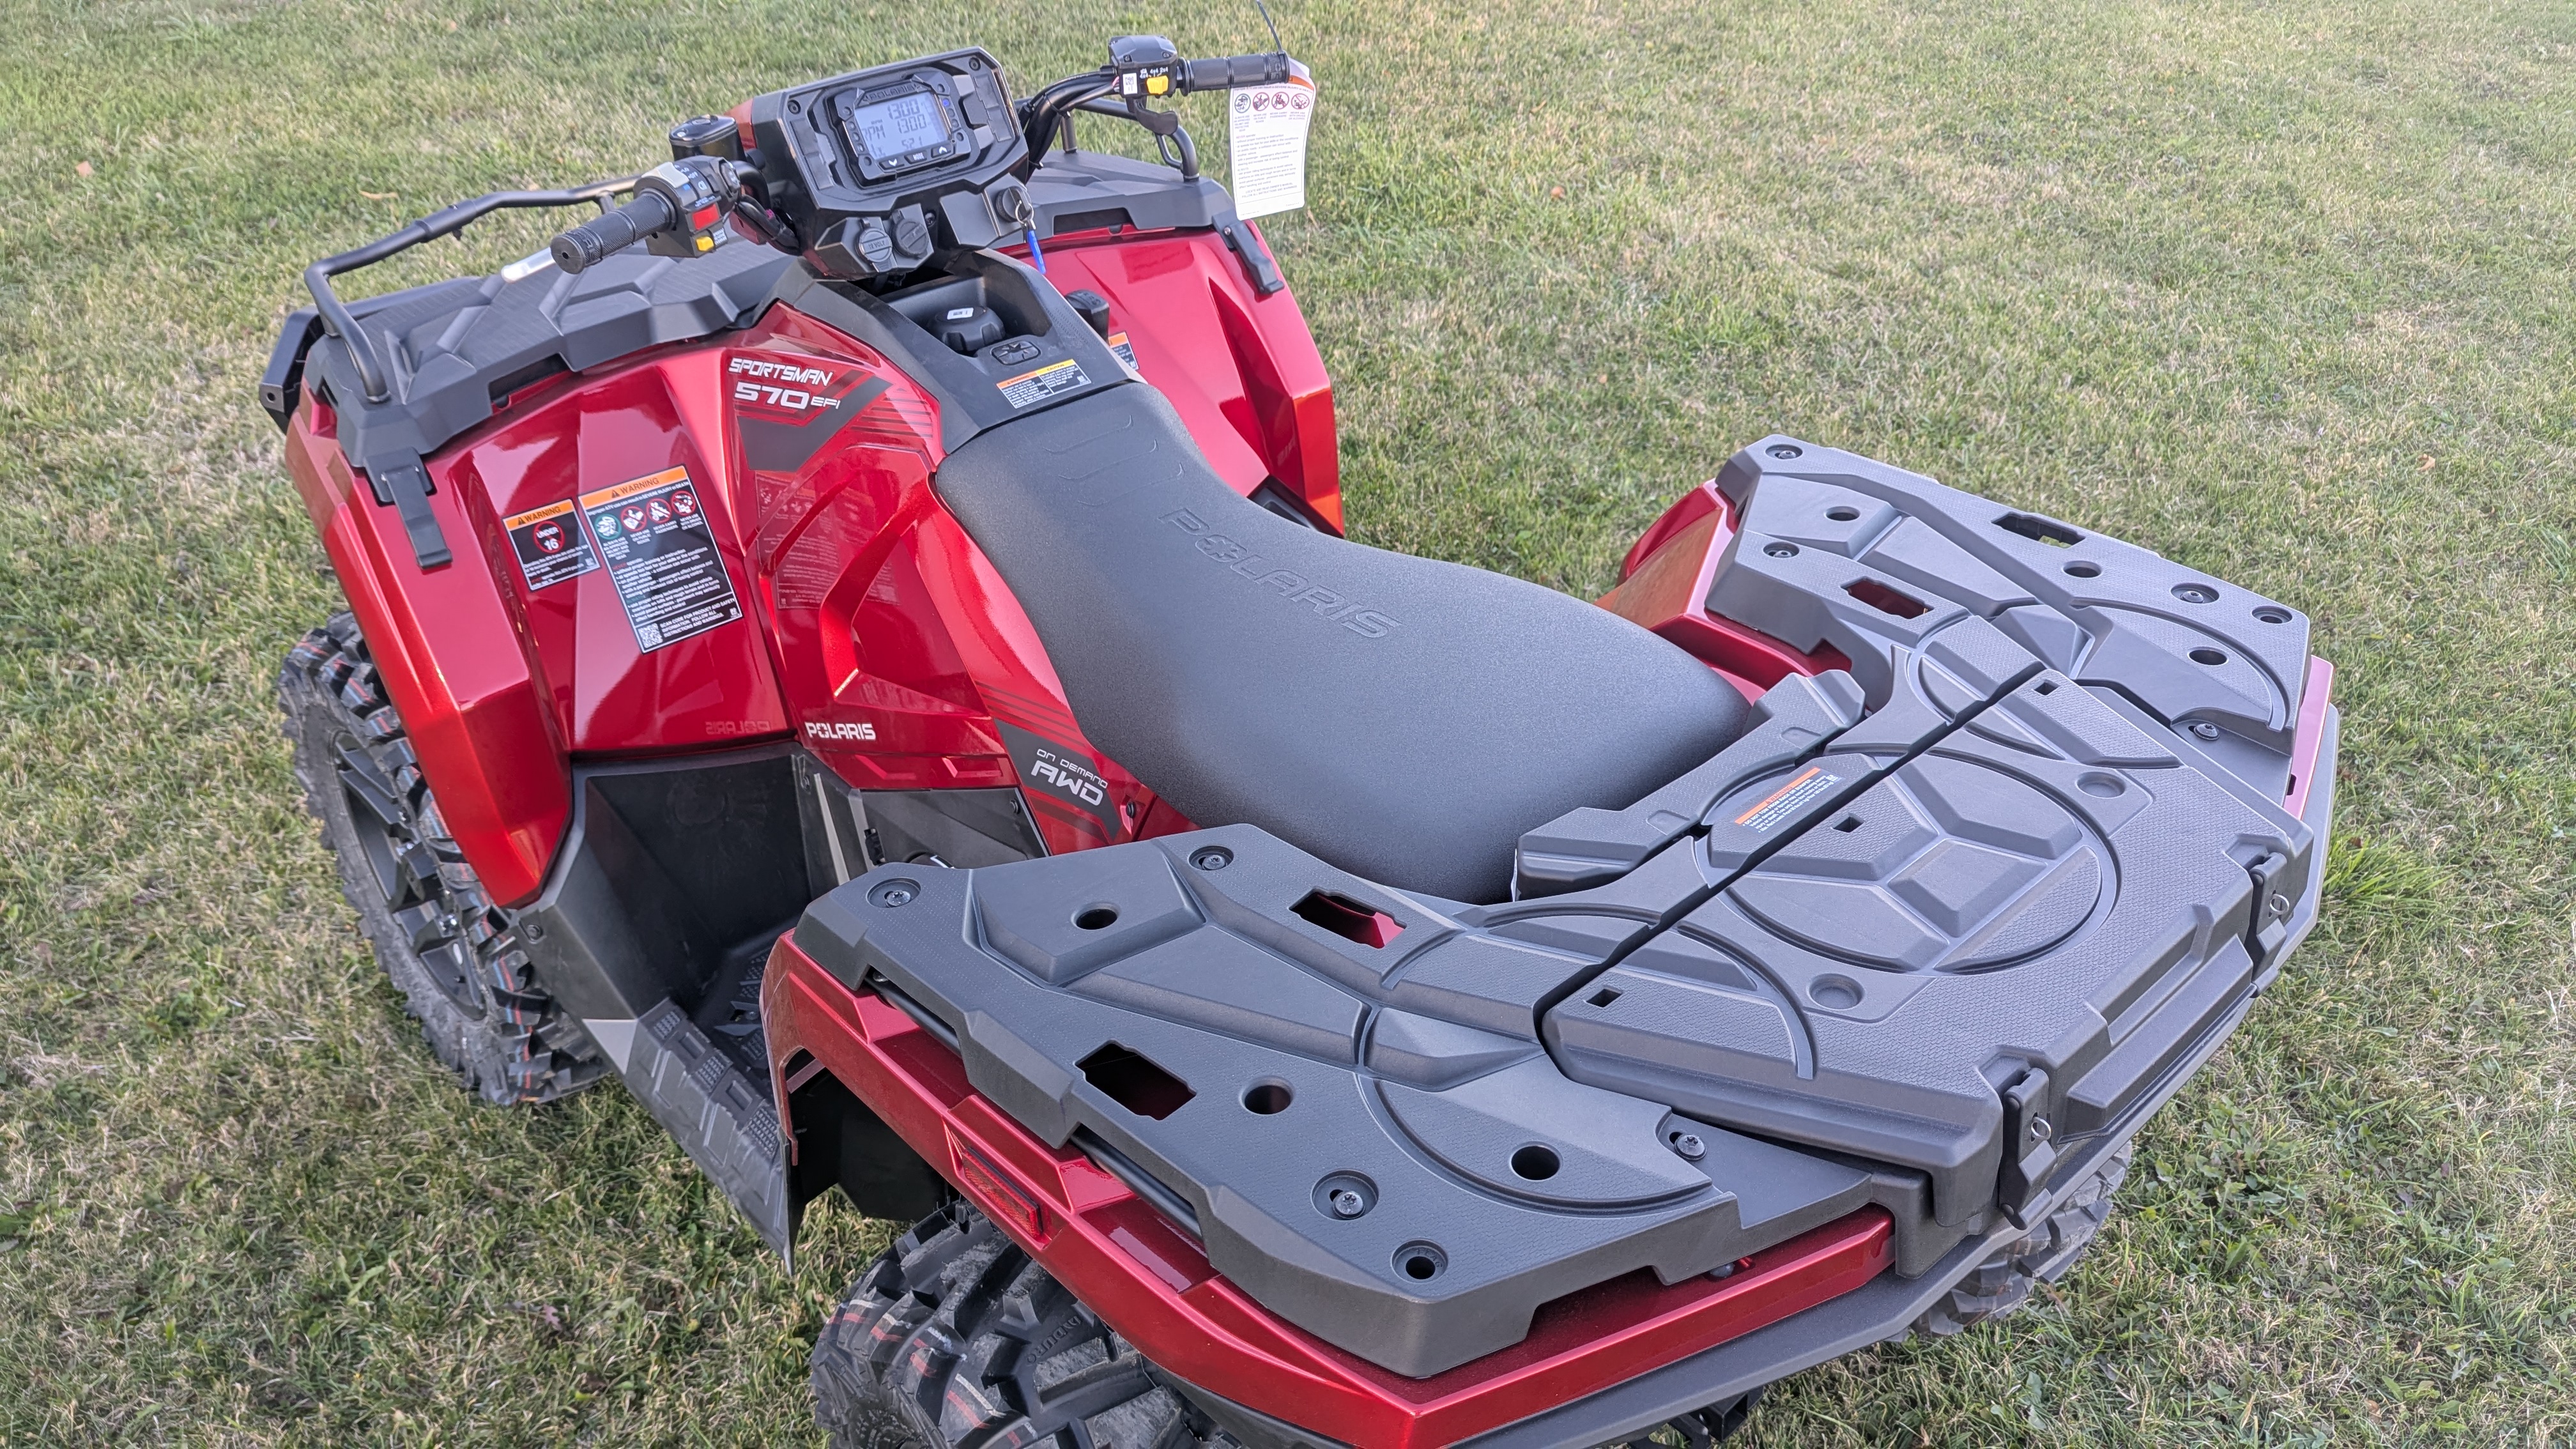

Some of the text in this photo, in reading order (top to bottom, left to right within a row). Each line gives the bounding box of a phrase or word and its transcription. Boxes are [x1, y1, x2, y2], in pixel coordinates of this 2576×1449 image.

[728, 358, 832, 386] SPORTSMAN
[735, 381, 841, 410] 570 EFI
[620, 478, 659, 494] WARNING
[525, 507, 561, 521] WARNING
[544, 538, 559, 550] 16
[1156, 507, 1407, 638] POLARIS
[804, 721, 876, 740] POLARIS
[1036, 749, 1108, 788] ON DEMAND
[1031, 760, 1103, 806] AWD
